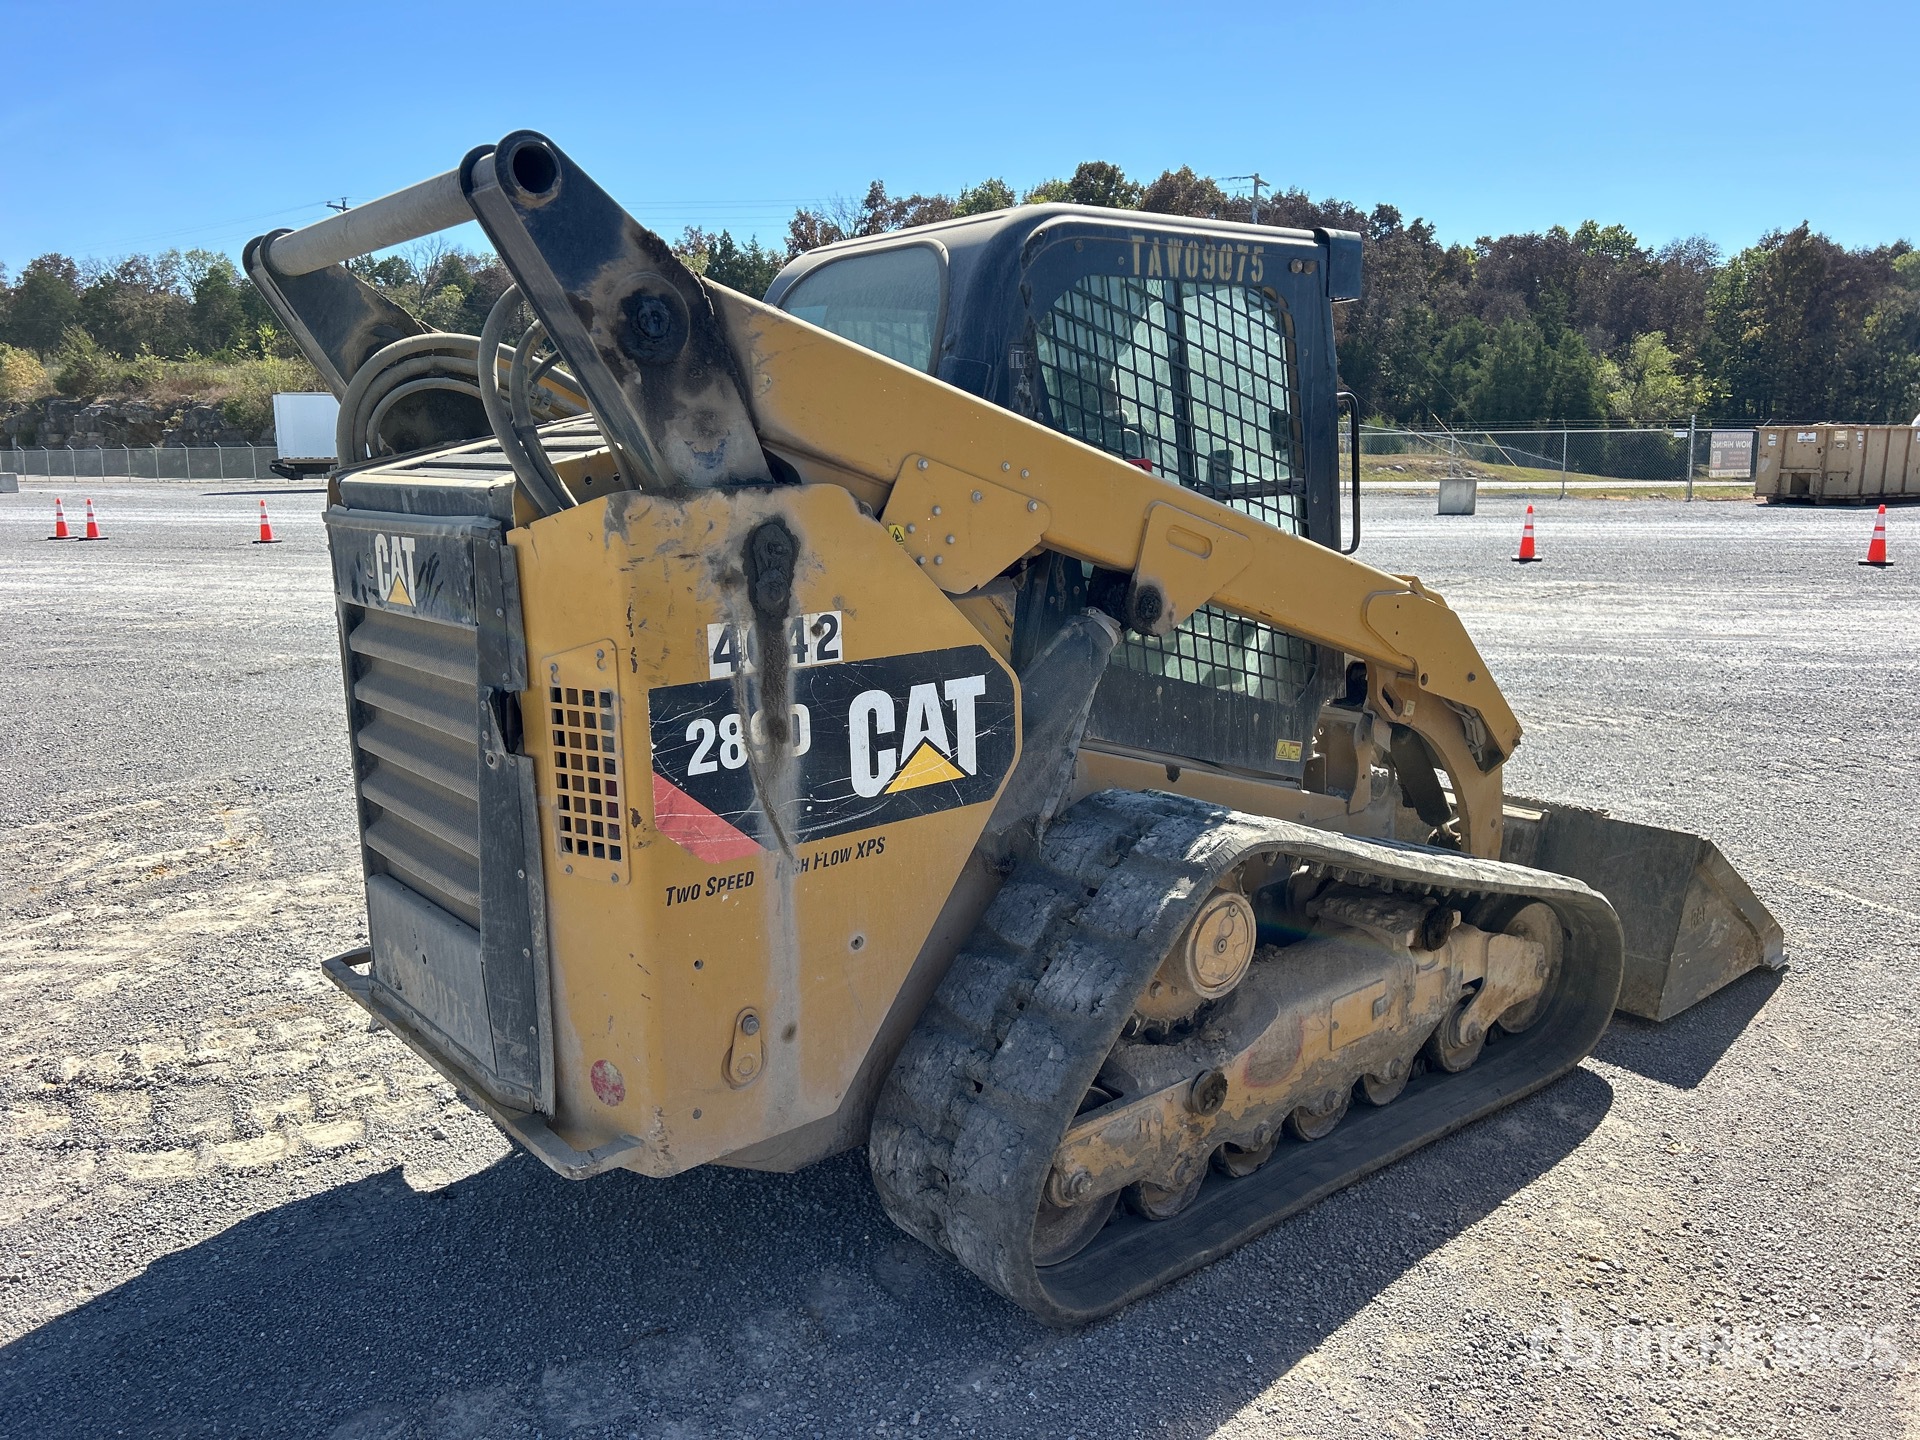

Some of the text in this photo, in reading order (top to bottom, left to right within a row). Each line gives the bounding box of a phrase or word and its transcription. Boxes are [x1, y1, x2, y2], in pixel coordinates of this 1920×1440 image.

[1131, 234, 1265, 283] TAW09075
[374, 533, 417, 607] CAT
[848, 674, 987, 799] CAT
[855, 836, 886, 860] XPS
